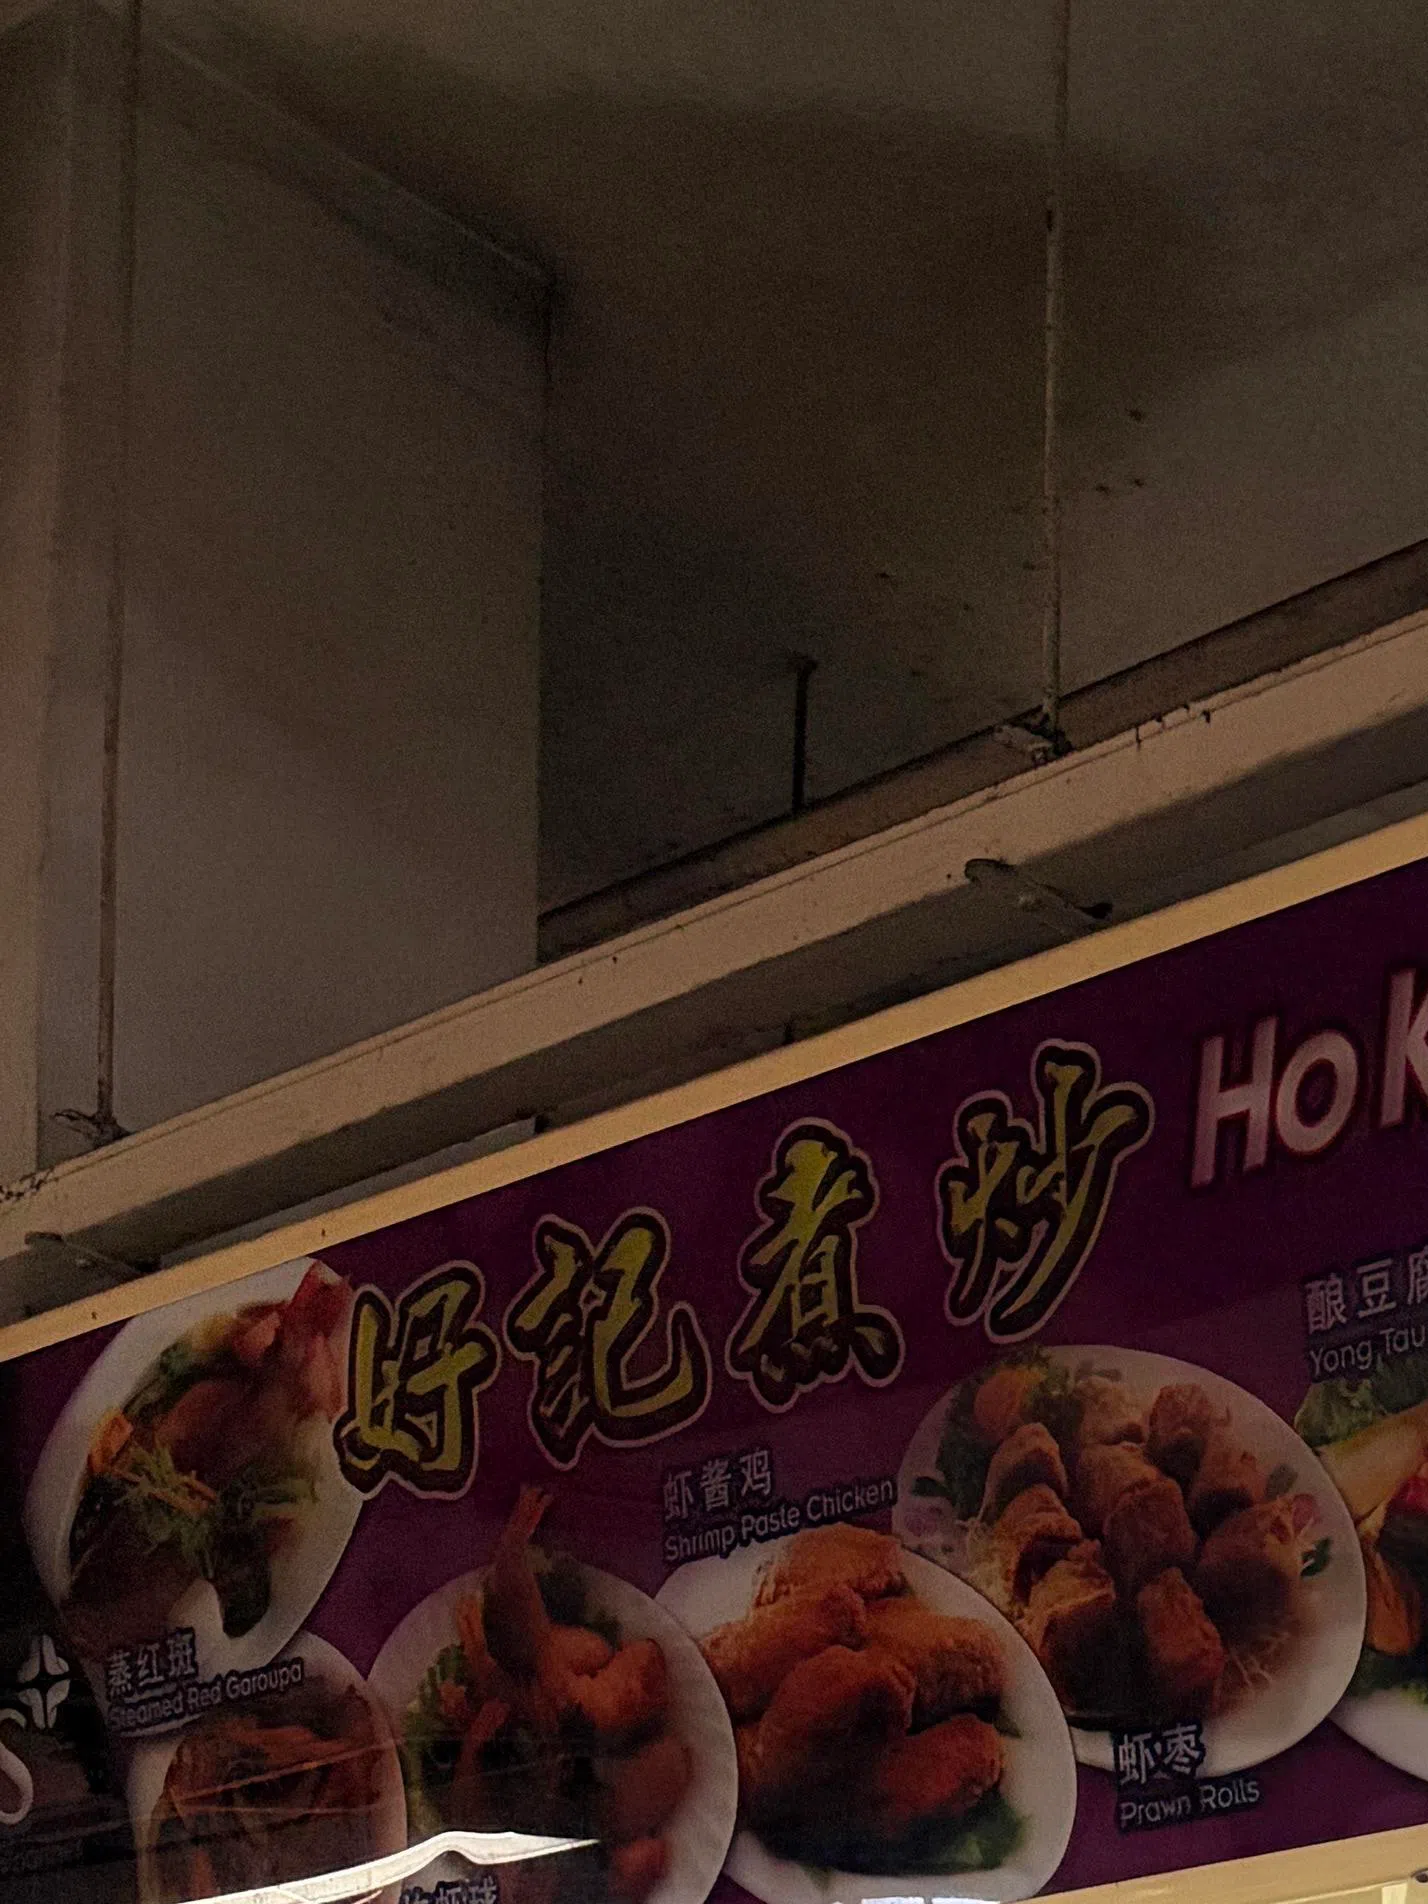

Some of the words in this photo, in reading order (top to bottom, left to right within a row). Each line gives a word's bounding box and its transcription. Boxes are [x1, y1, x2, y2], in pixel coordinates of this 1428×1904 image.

[1190, 1013, 1358, 1186] Ho
[1309, 1340, 1373, 1377] Yong
[1380, 1325, 1426, 1355] Tau
[662, 1448, 773, 1522] 虾酱鸡
[663, 1524, 736, 1562] Shrimp
[740, 1503, 801, 1541] Paste
[806, 1479, 895, 1521] Chicken
[225, 1661, 305, 1699] Garoupa
[1118, 1722, 1201, 1786] 虾枣
[1119, 1796, 1192, 1829] Prawn
[1199, 1779, 1261, 1812] Rolls
